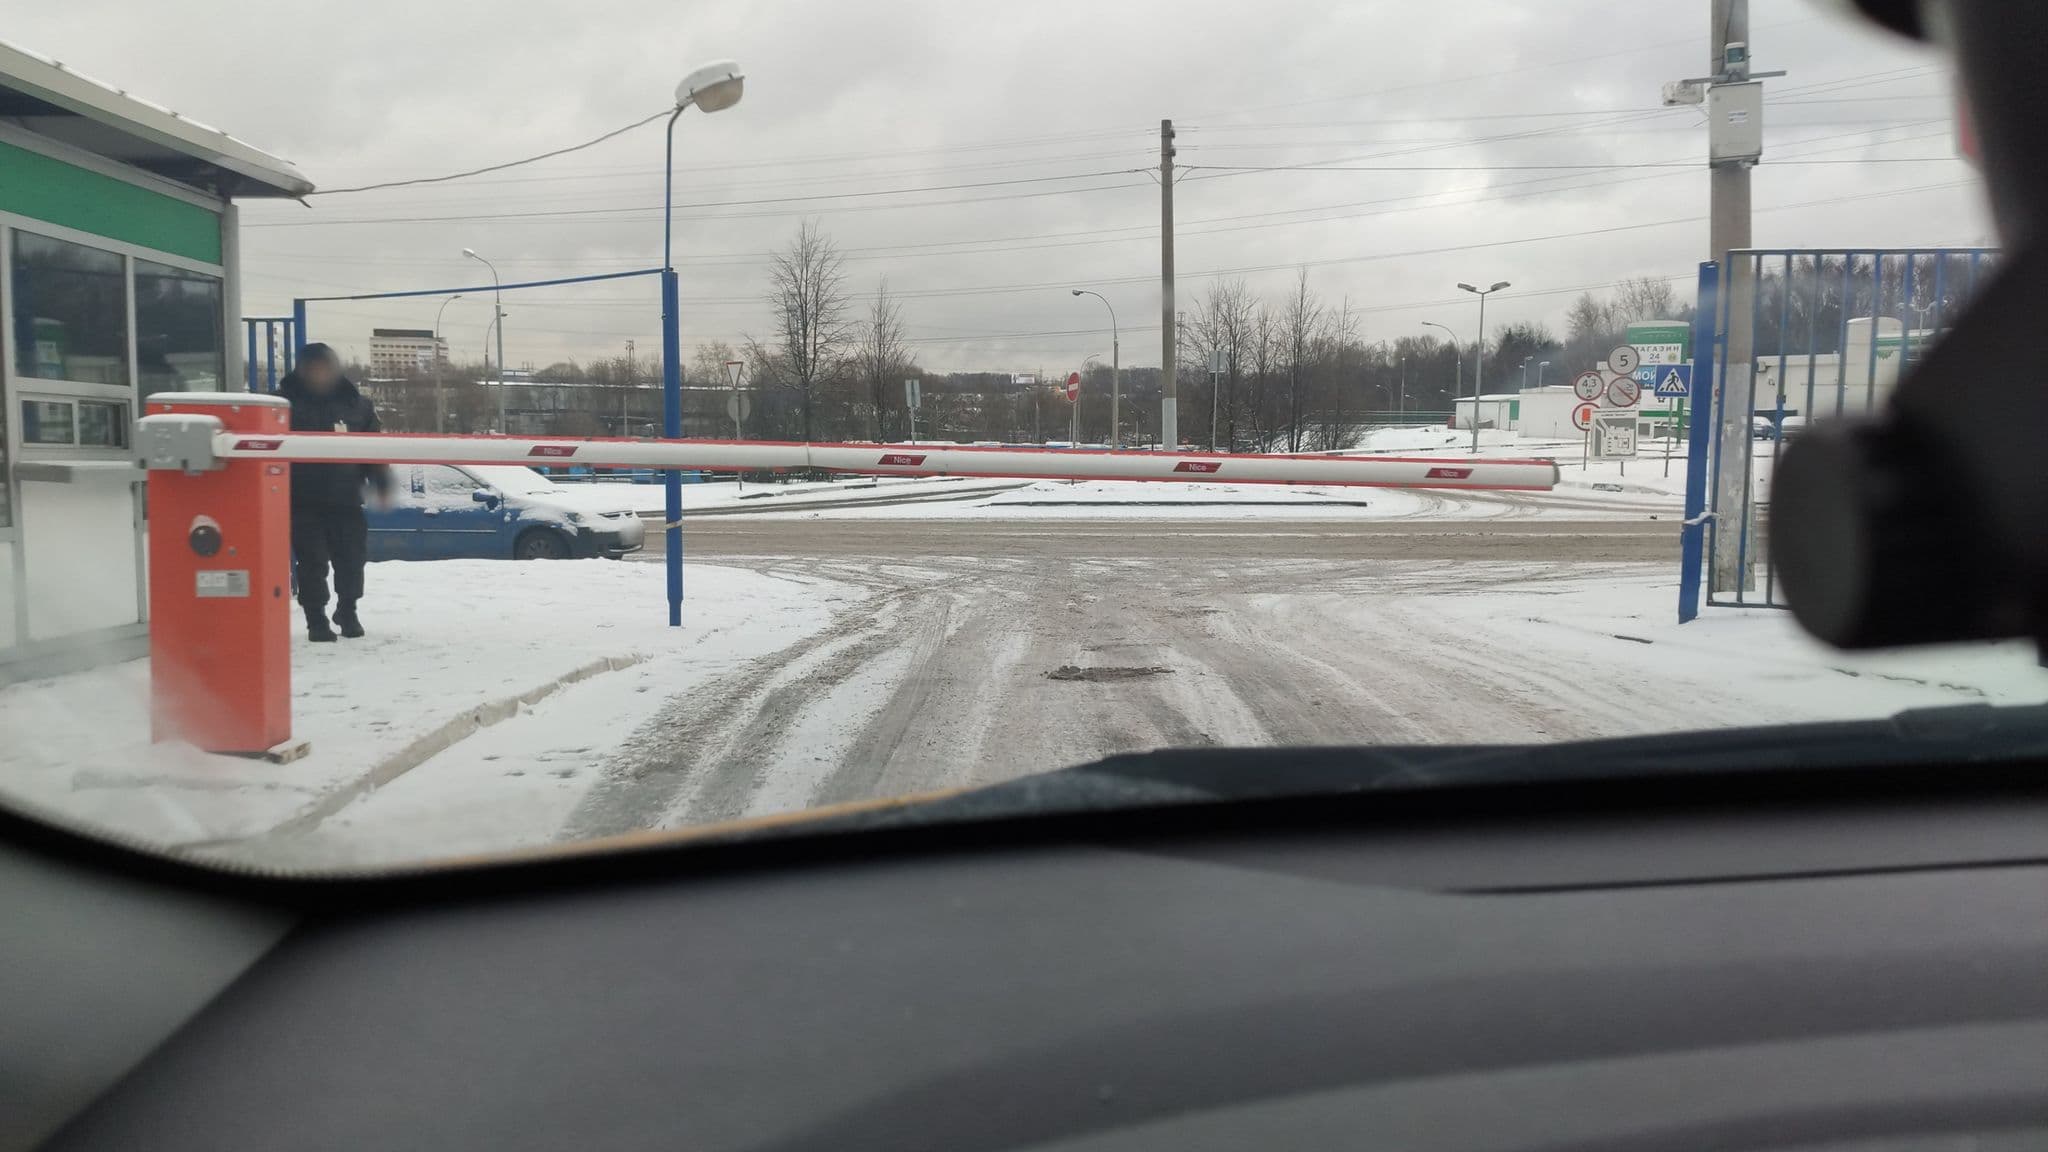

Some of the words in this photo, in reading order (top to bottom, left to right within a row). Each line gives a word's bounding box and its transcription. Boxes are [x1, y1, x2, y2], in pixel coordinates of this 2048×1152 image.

[1620, 354, 1629, 367] 5
[893, 455, 912, 464] Nice
[1189, 463, 1207, 471] Nice
